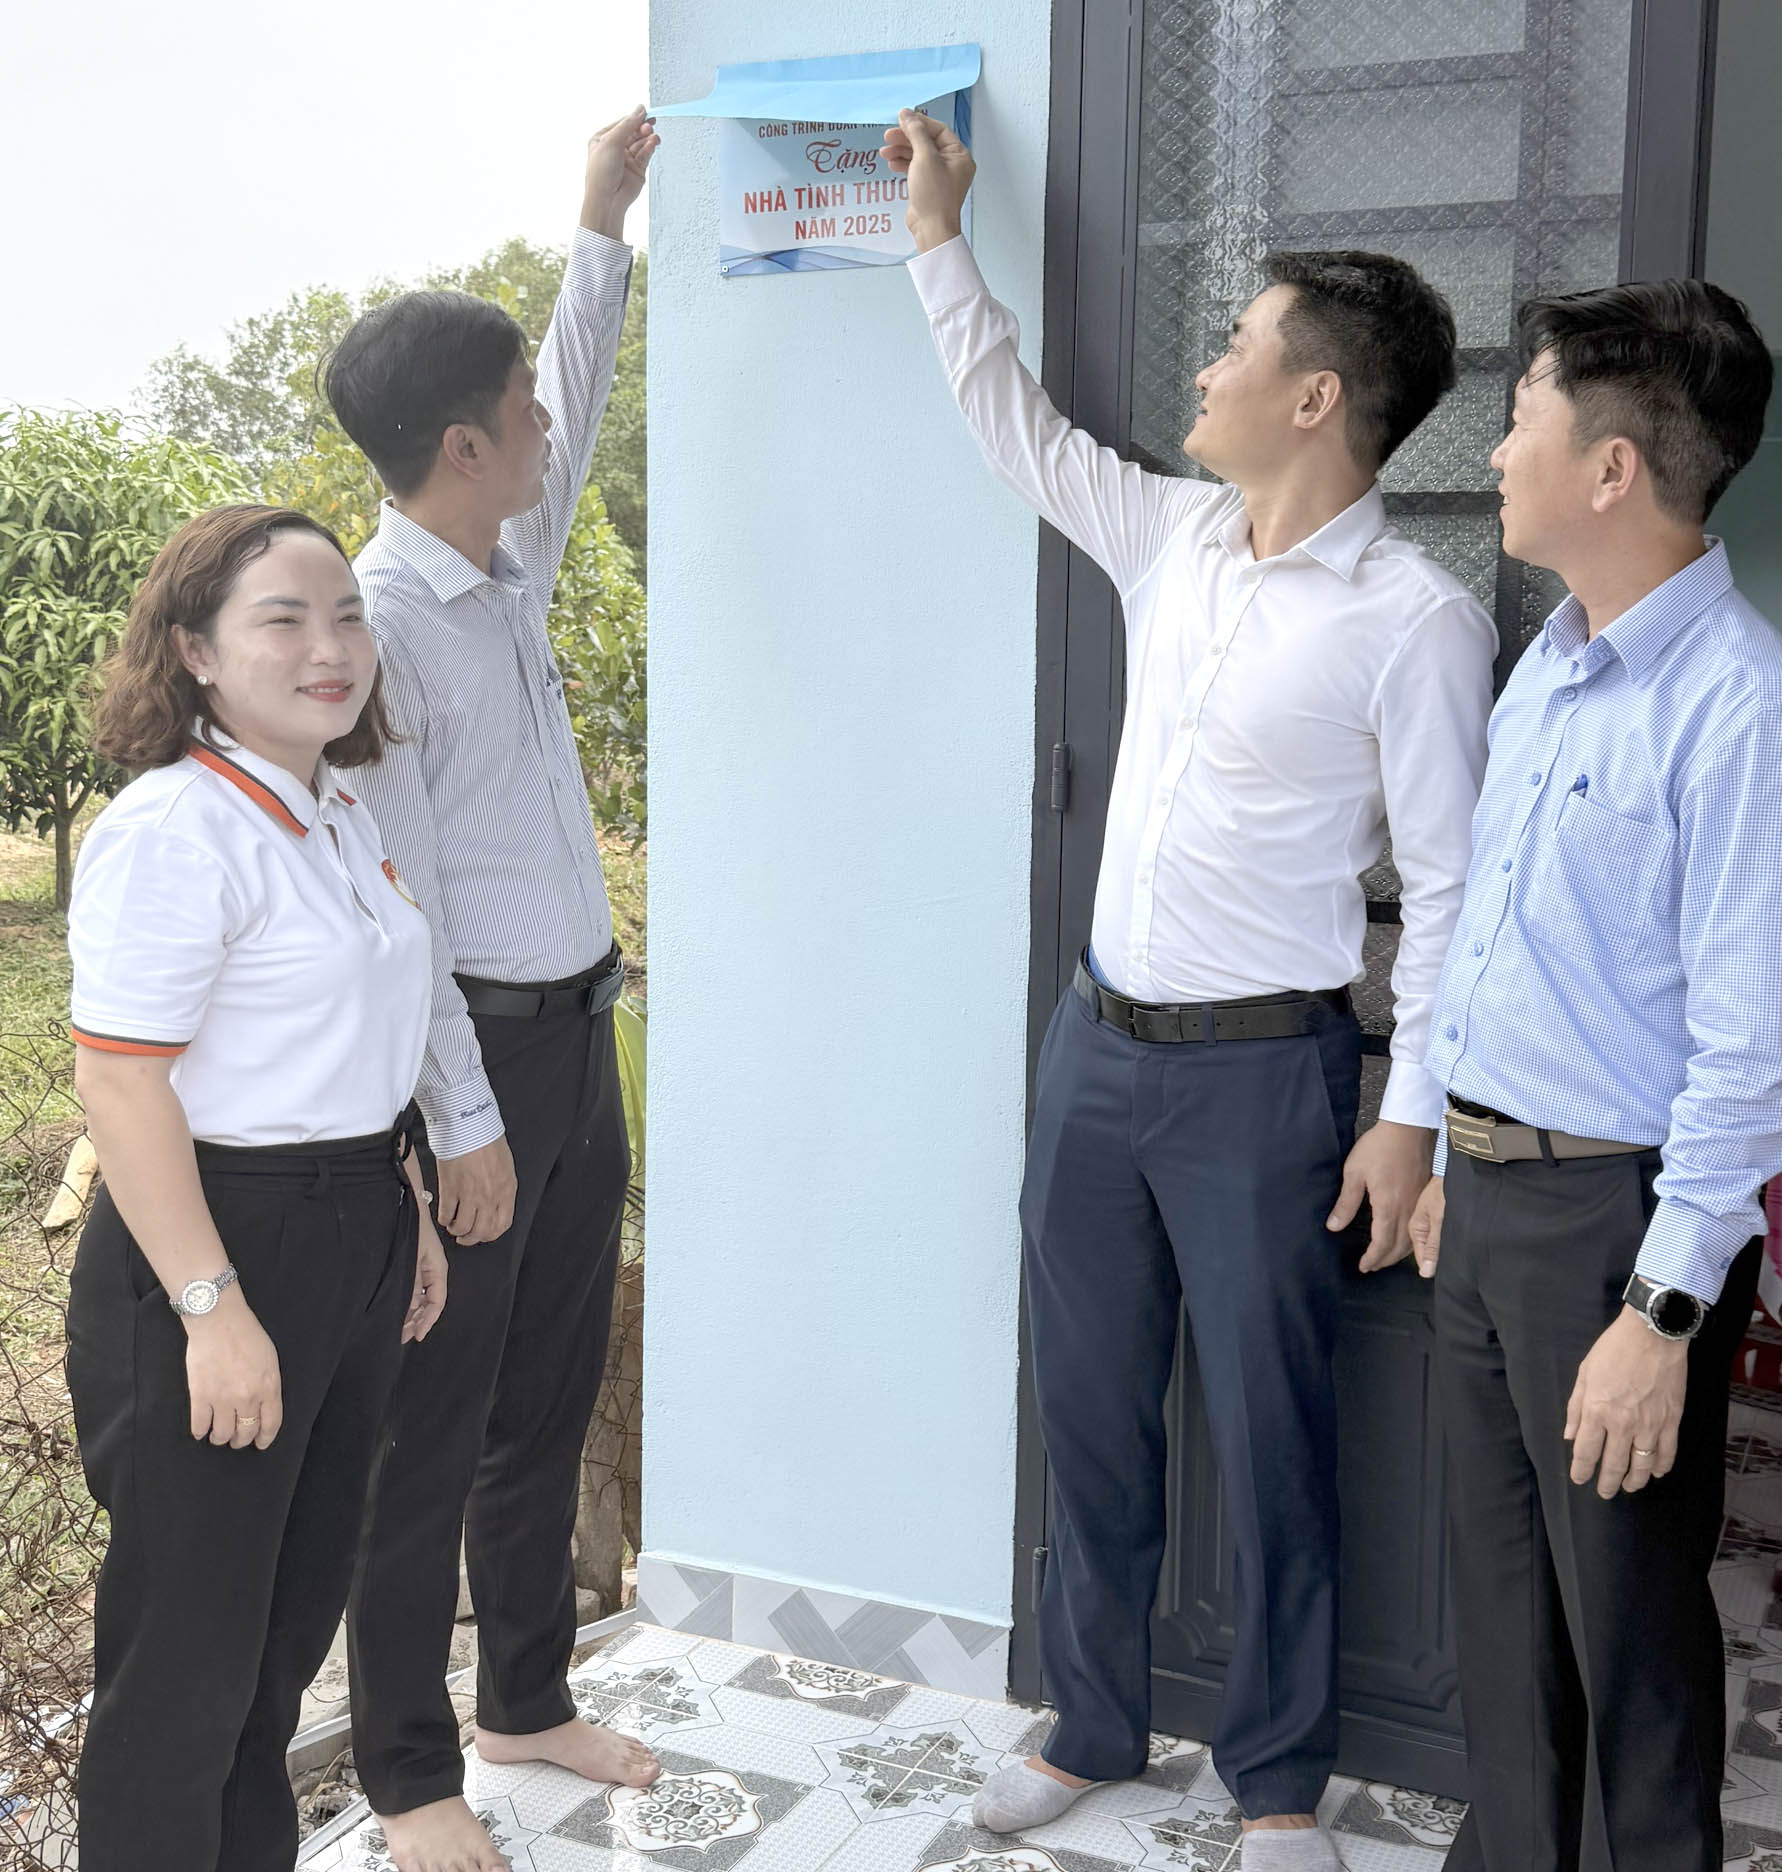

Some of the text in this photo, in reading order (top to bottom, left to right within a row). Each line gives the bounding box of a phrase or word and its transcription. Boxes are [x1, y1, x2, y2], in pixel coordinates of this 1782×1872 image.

[757, 123, 789, 139] CÔNG
[805, 139, 880, 175] Tặng
[744, 186, 788, 214] NHÀ
[794, 183, 845, 210] TÌNH
[794, 213, 892, 240] NĂM 2025
